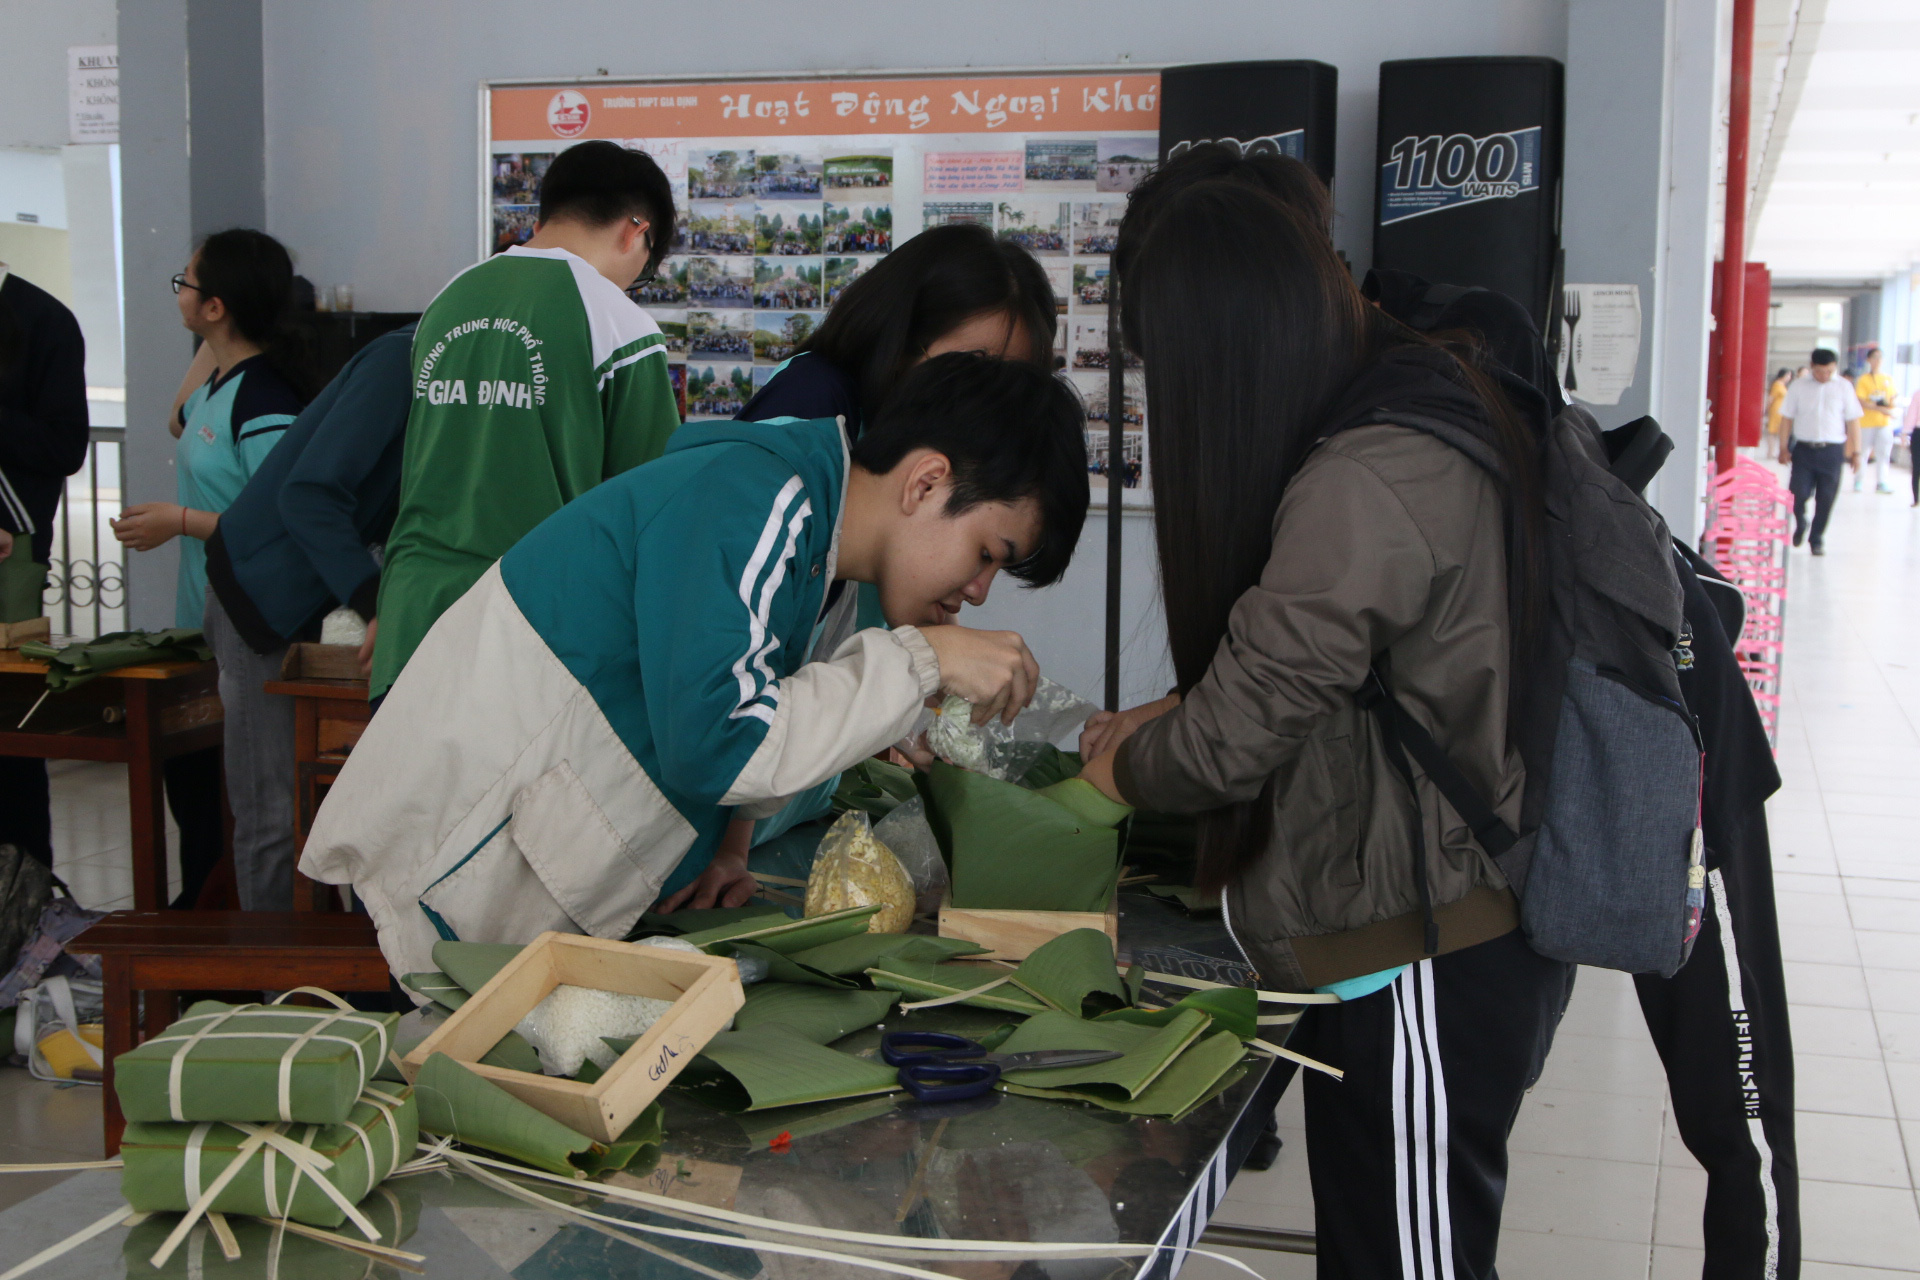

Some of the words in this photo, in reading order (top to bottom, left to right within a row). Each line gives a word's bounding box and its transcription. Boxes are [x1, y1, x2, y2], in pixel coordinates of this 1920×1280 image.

[79, 56, 103, 66] KHU
[638, 97, 659, 108] THPT
[660, 97, 675, 107] GIA
[719, 91, 810, 125] Hoạt
[831, 92, 930, 130] Động
[951, 86, 1060, 129] Ngoại
[1390, 133, 1519, 189] 1100
[1523, 162, 1533, 185] M15
[1462, 181, 1520, 198] WATTS
[445, 317, 490, 342] TRUNG
[493, 318, 518, 333] HỌC
[516, 326, 543, 350] PHỔ
[416, 341, 446, 399] TRƯỜNG
[529, 352, 549, 406] THÔNG
[428, 379, 468, 405] GIA
[478, 380, 532, 410] ĐỊNH
